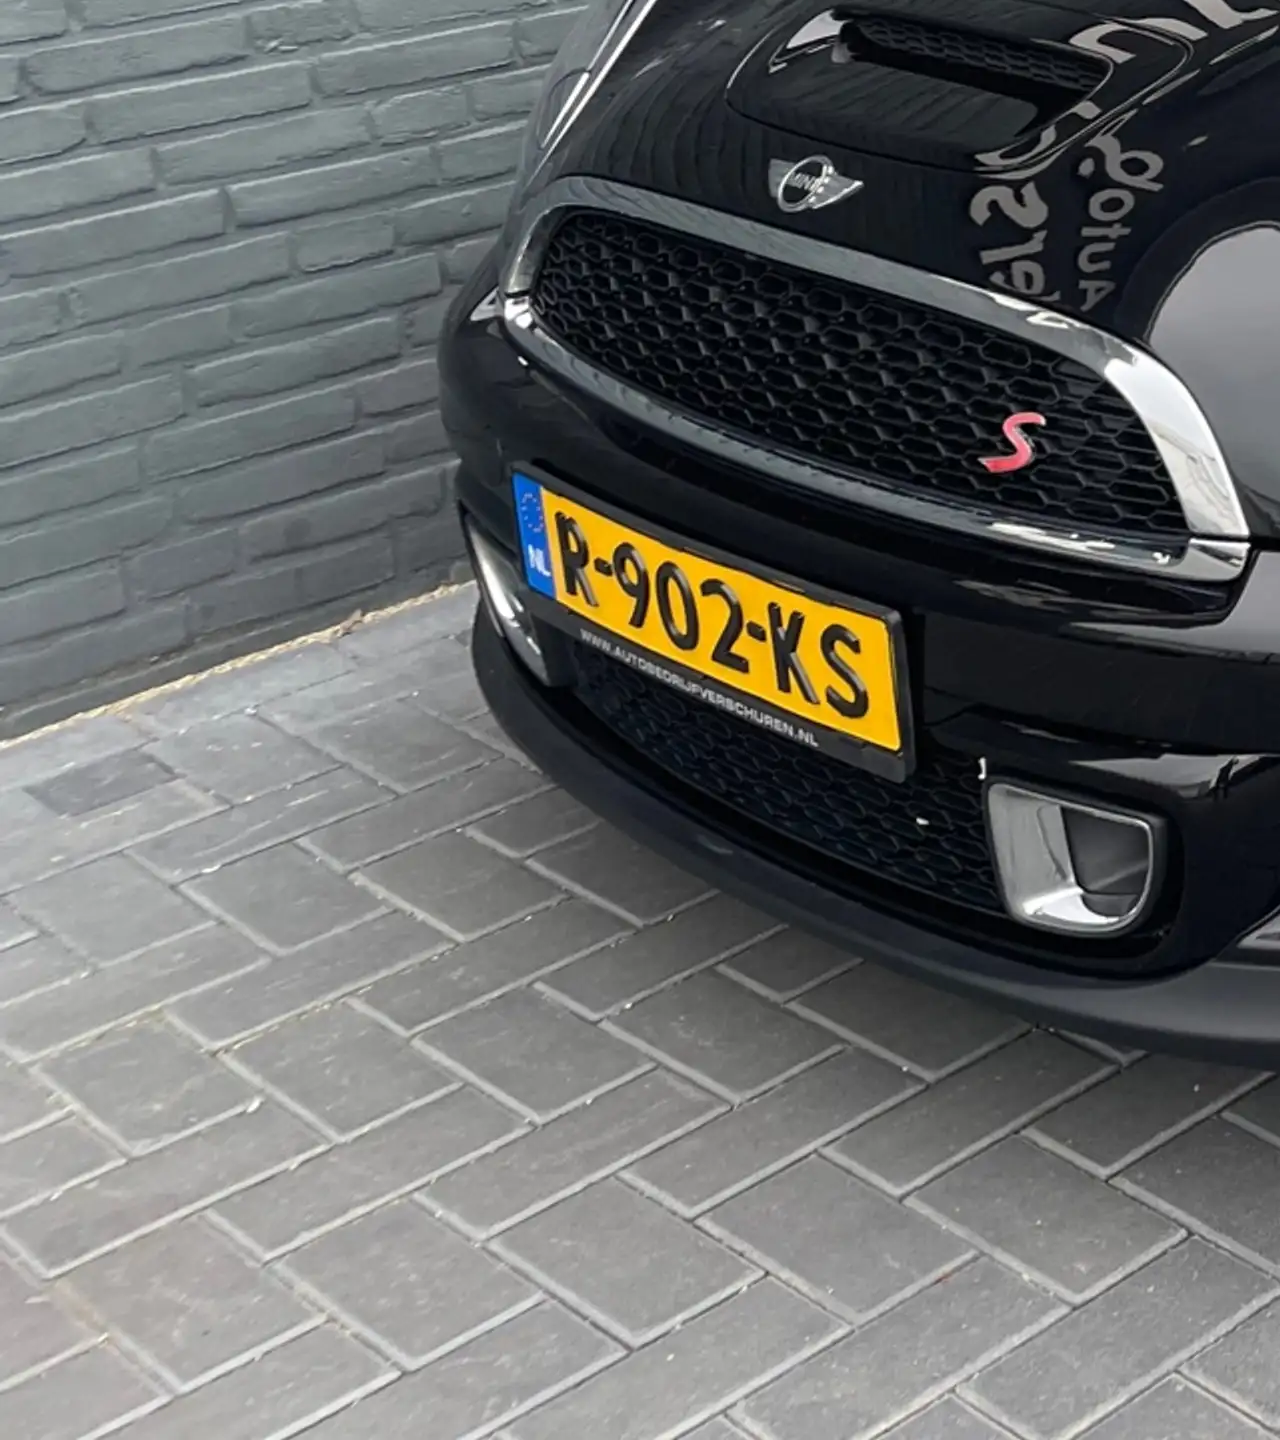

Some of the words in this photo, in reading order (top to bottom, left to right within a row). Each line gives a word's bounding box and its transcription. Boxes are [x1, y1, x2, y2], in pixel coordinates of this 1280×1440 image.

[978, 411, 1047, 473] S
[528, 544, 551, 577] NL
[554, 511, 869, 719] R-902-KS
